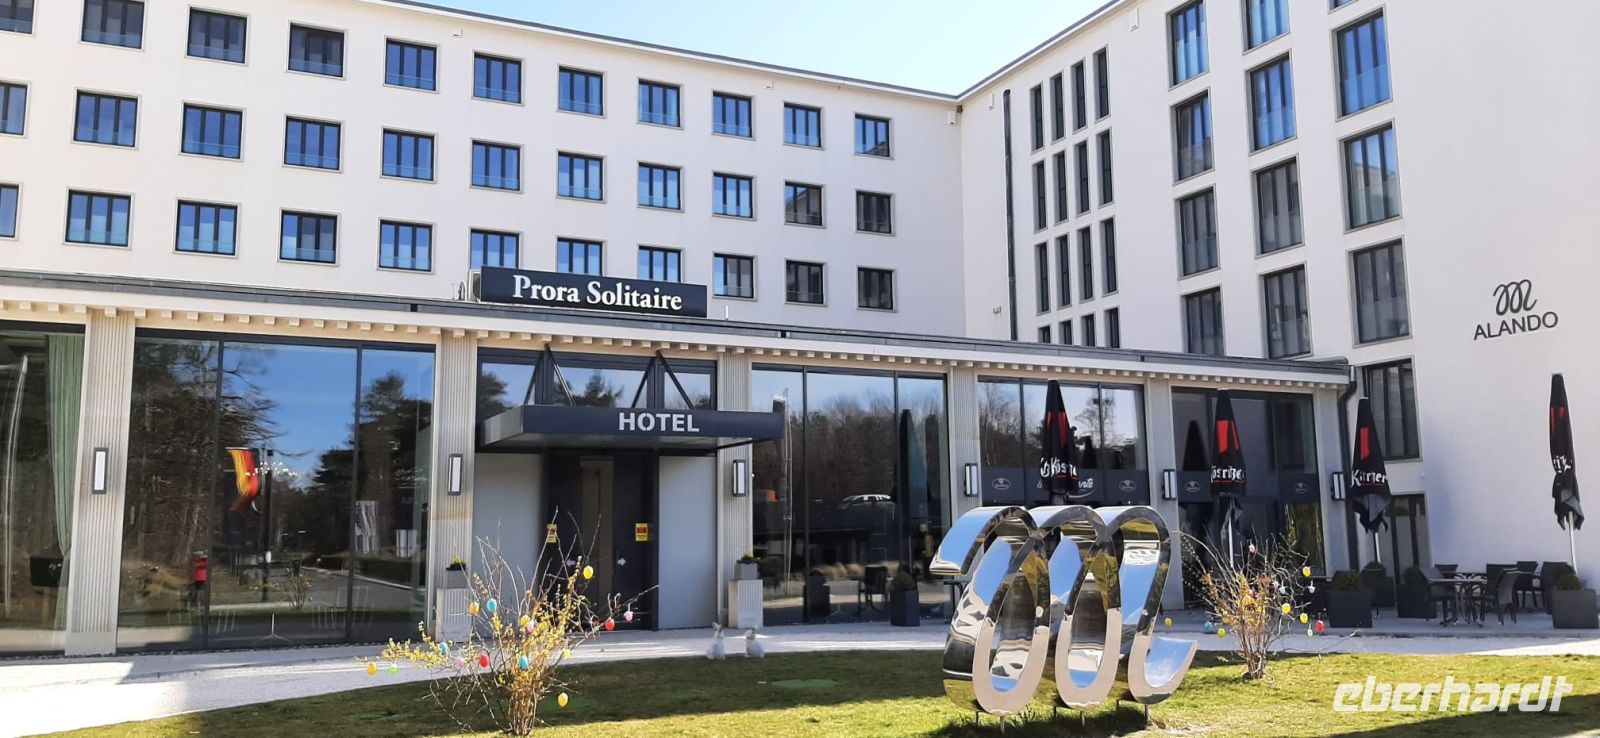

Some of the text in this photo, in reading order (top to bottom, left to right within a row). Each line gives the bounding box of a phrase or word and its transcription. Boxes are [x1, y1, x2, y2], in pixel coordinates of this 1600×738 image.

[512, 274, 683, 310] Prora Solitaire
[1474, 311, 1558, 340] ALANDO
[618, 412, 700, 432] HOTEL
